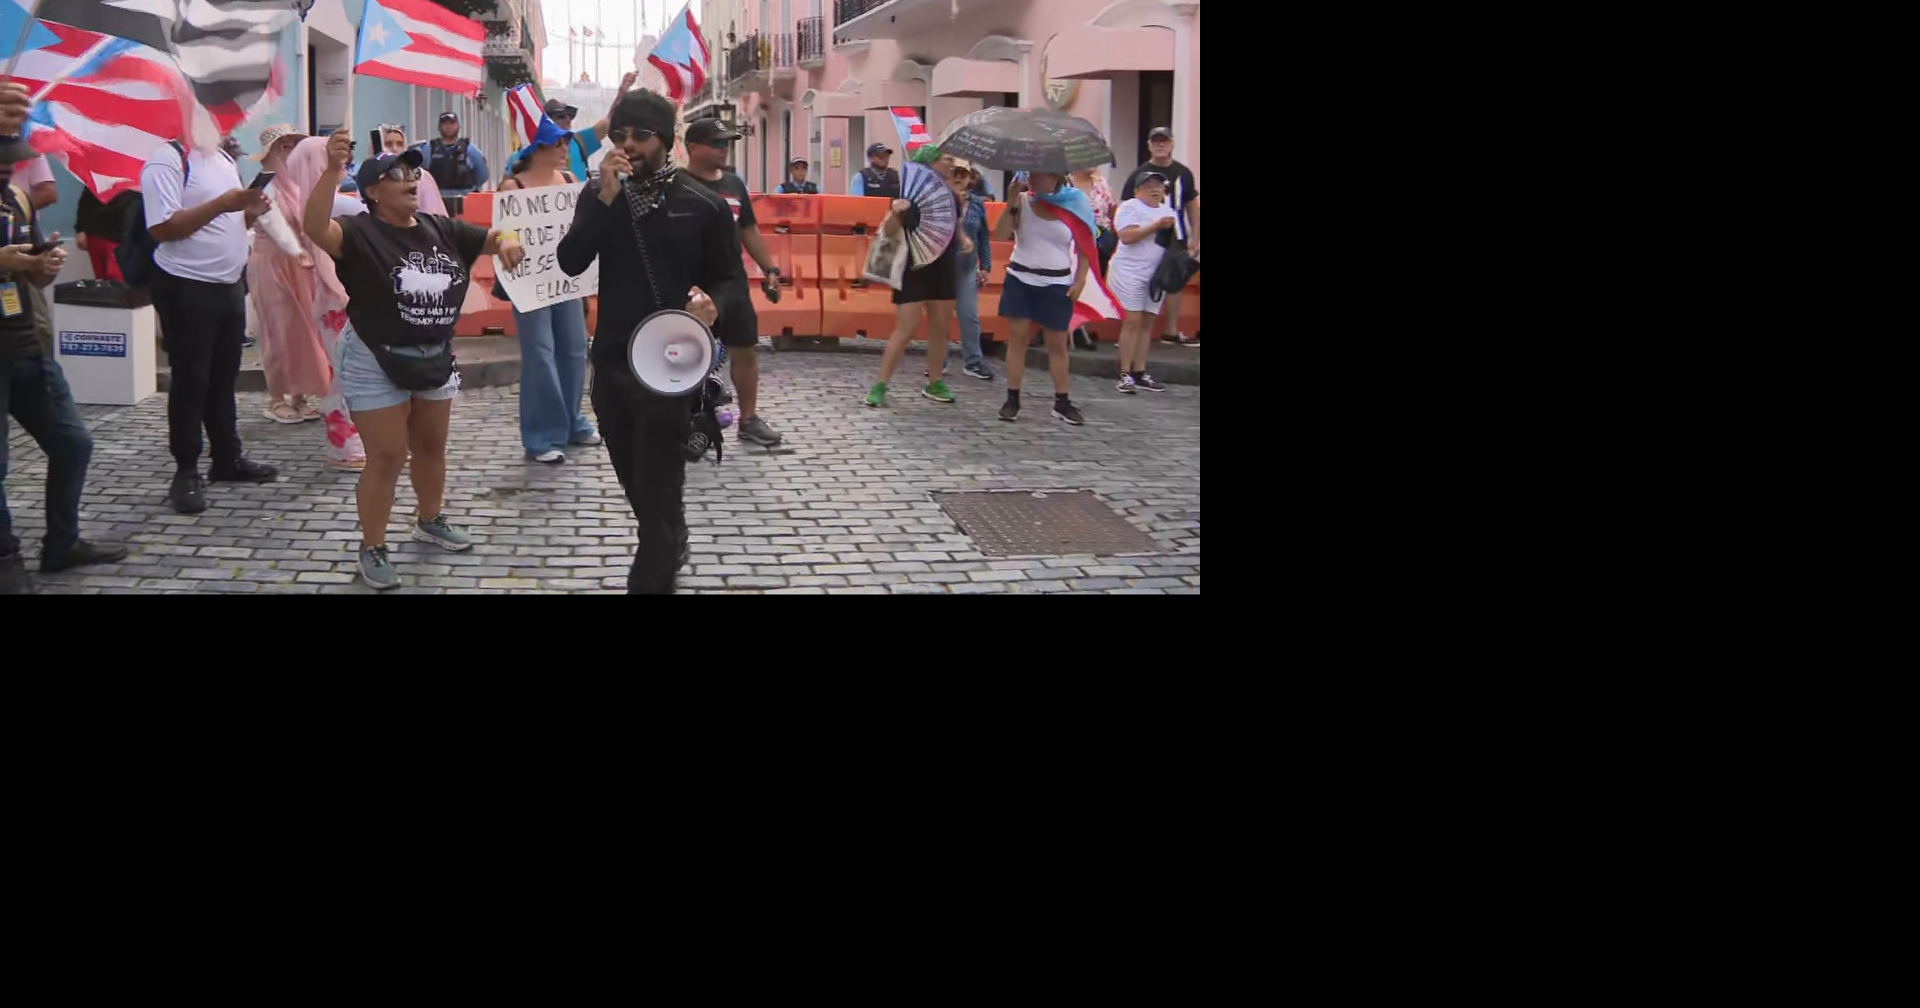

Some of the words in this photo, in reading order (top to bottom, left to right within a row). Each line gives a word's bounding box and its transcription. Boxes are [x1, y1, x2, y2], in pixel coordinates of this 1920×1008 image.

[499, 194, 522, 221] NO
[525, 194, 552, 216] ME
[536, 225, 554, 246] DE
[535, 252, 555, 275] SE
[536, 278, 580, 302] ELLOS
